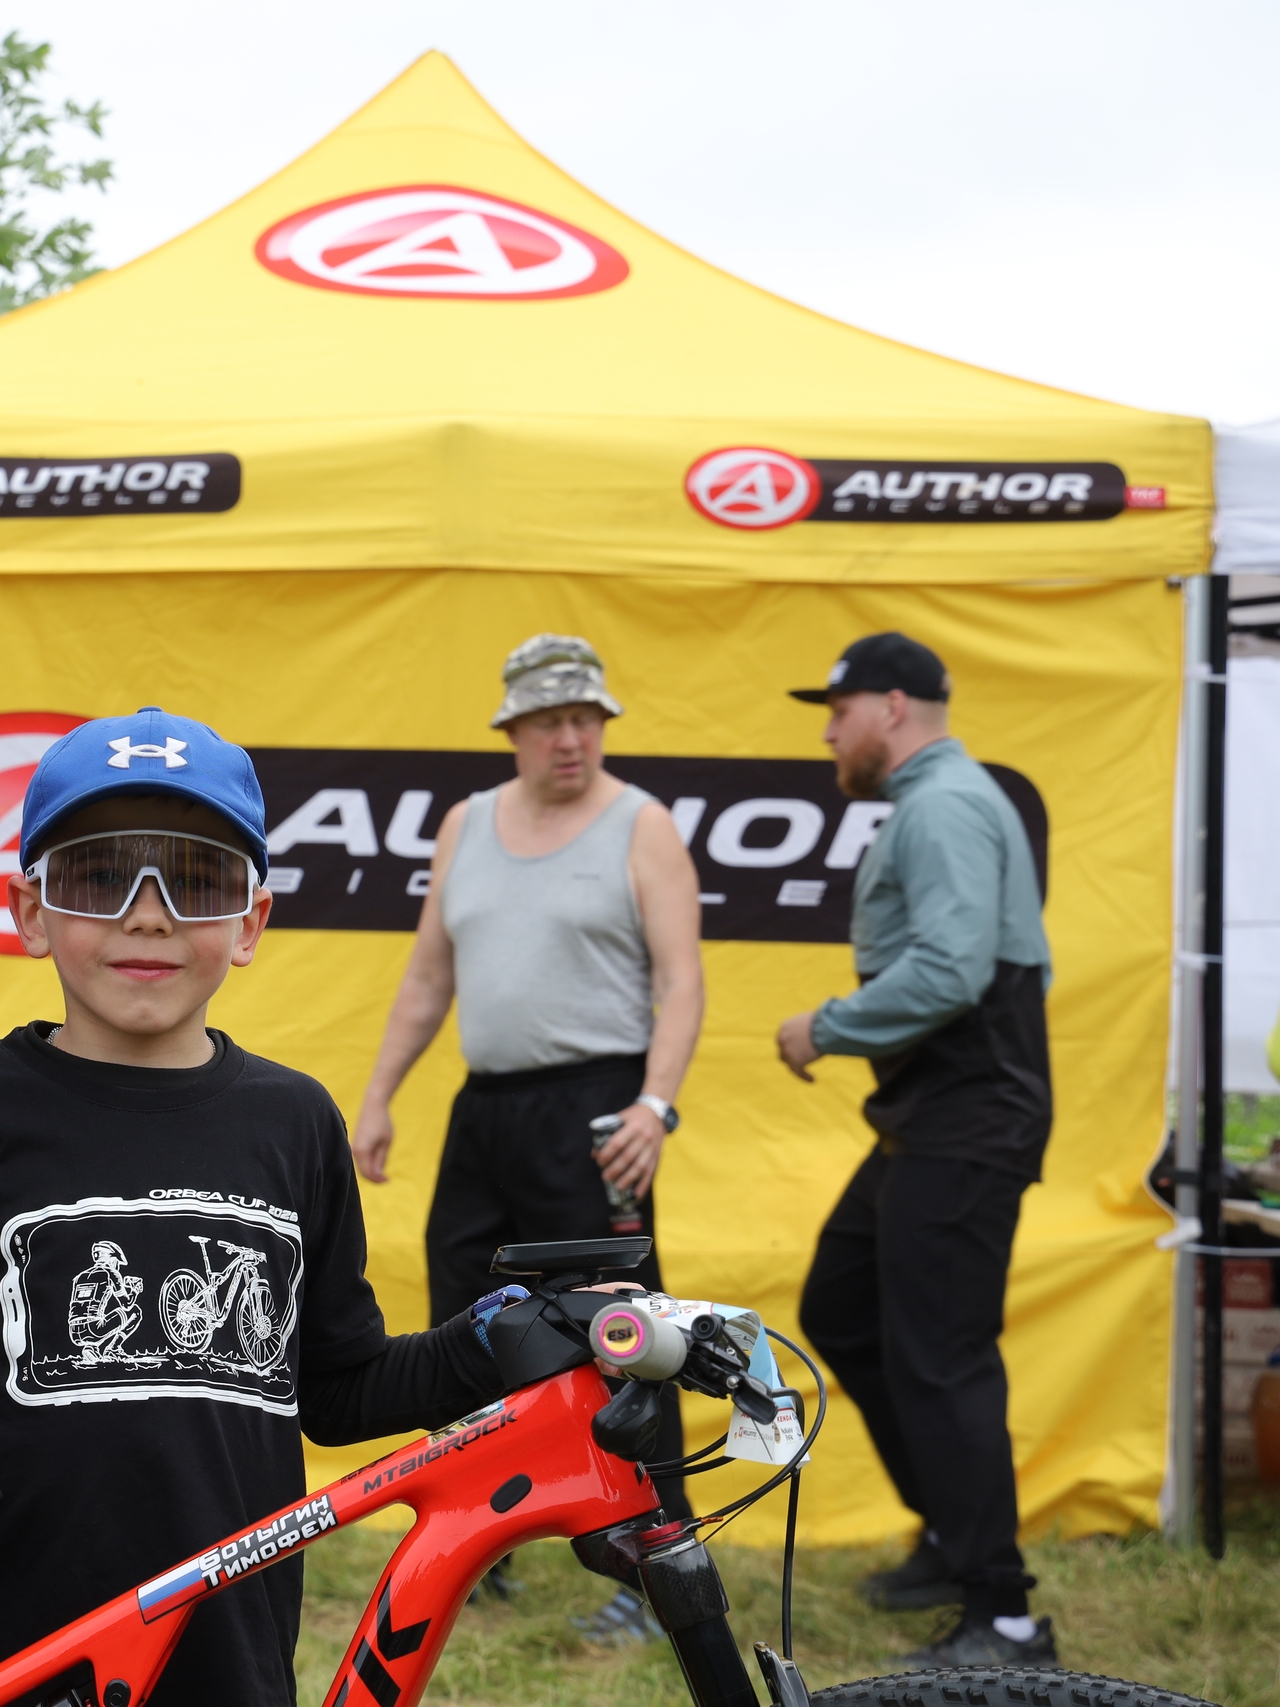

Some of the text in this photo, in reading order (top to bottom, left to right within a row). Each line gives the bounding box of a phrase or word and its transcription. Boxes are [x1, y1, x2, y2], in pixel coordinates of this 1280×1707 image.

[833, 470, 1094, 502] AUTHOR
[148, 1188, 224, 1202] ORBEA
[228, 1194, 267, 1208] CUP
[363, 1408, 517, 1495] MTBIGROCK
